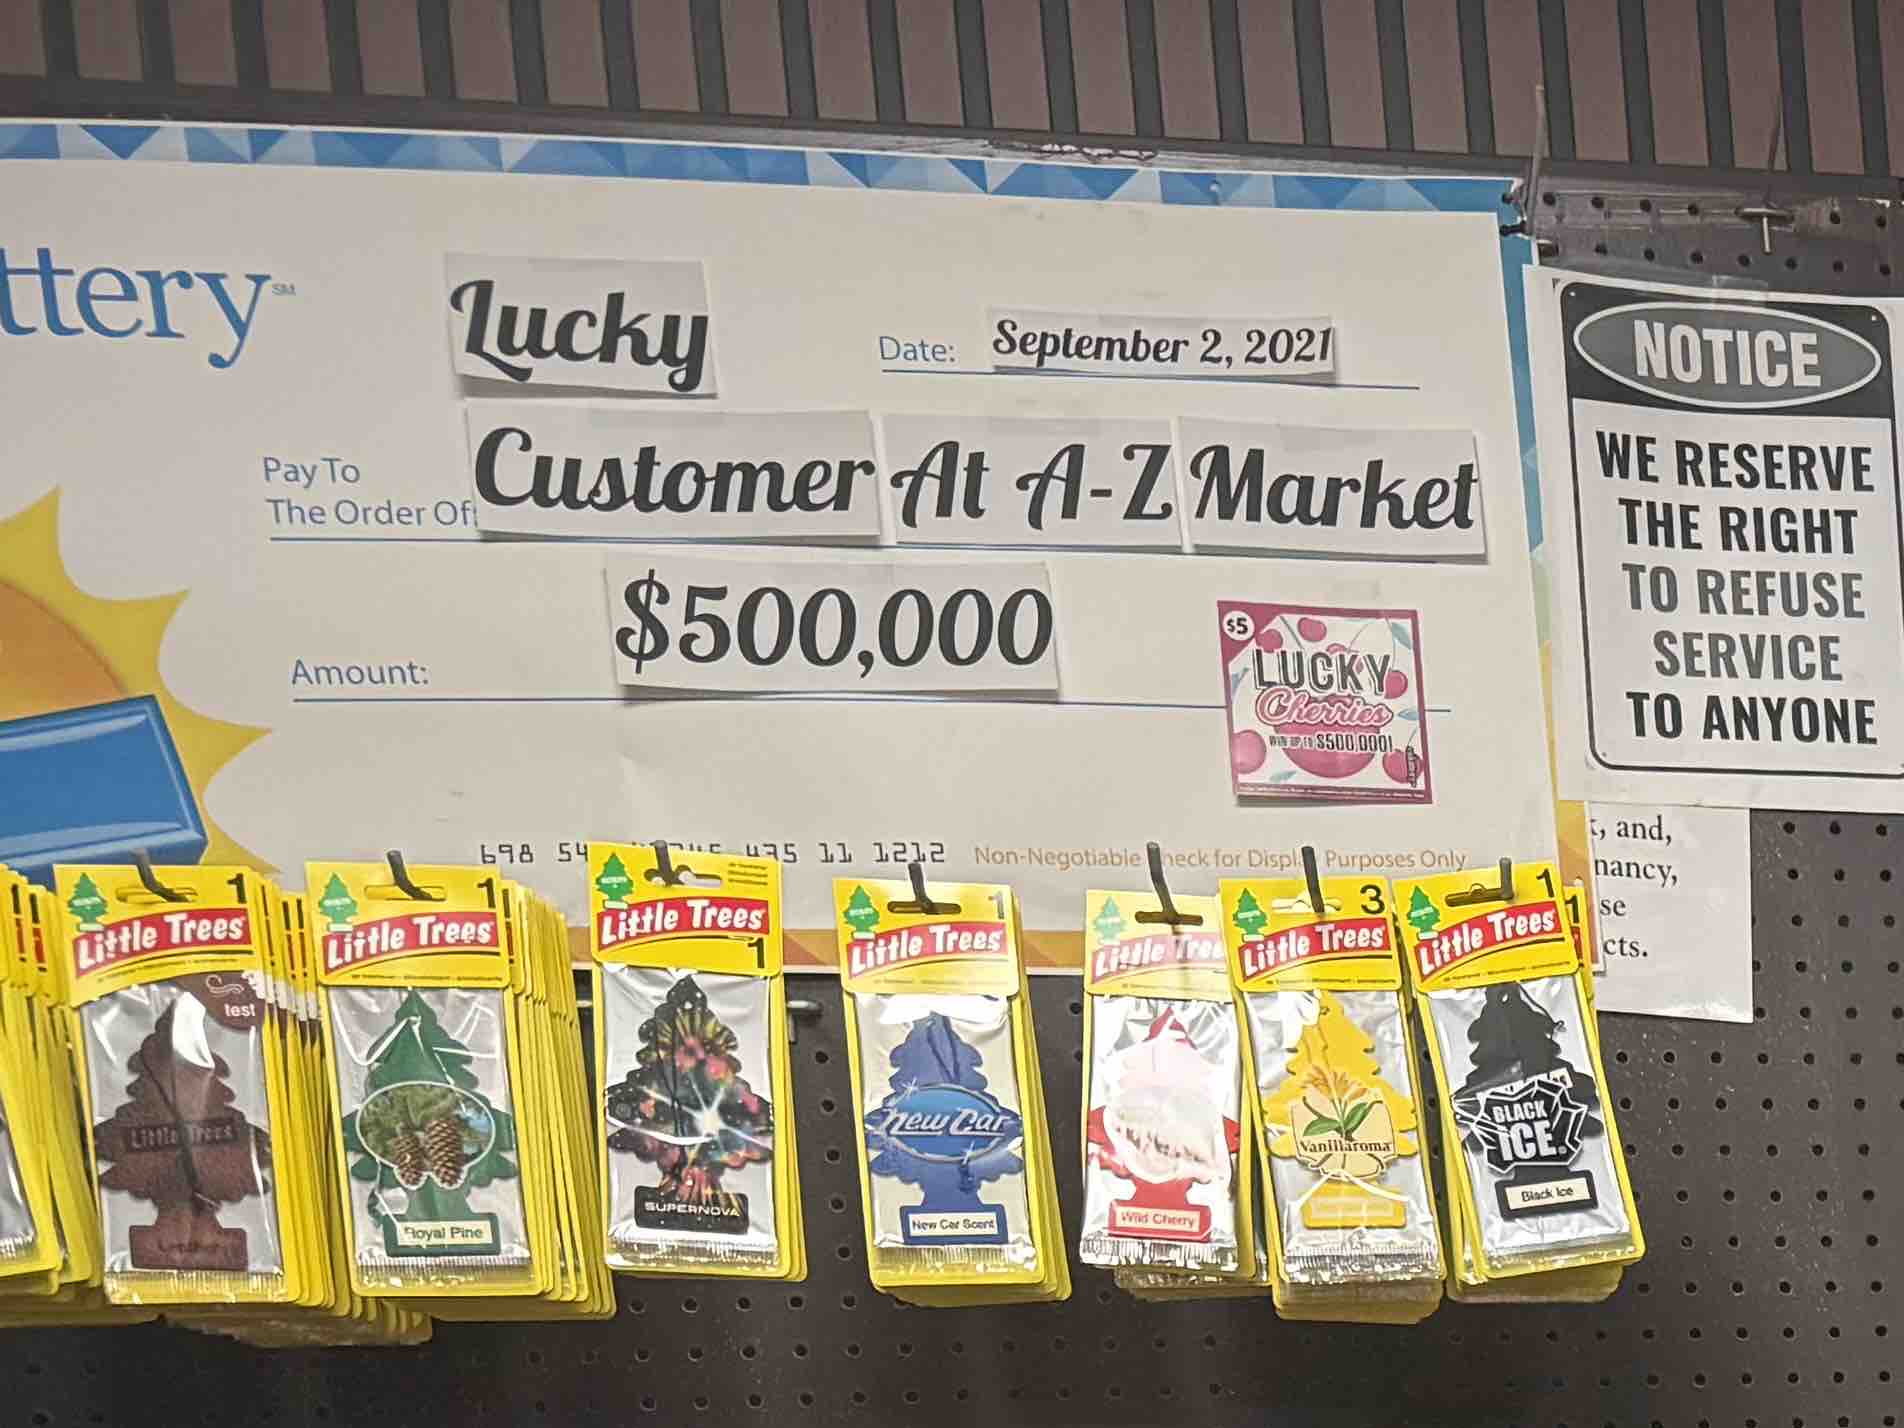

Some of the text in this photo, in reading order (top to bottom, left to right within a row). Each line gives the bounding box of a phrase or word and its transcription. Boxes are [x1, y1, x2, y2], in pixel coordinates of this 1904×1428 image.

[450, 278, 709, 392] Lucky
[878, 319, 1332, 368] Date: September 2, 2021
[1632, 319, 1822, 388] NOTICE
[263, 457, 361, 489] Pay To
[474, 426, 1478, 530] Customer At A-Z Market
[1596, 431, 1875, 494] WE RESERVE
[267, 499, 423, 525] The Order
[1618, 497, 1857, 555] THE RIGHT
[1622, 562, 1864, 621] TO REFUSE
[614, 568, 1055, 678] $500,000
[290, 659, 430, 688] Amount:
[1253, 648, 1390, 696] LUCKY
[1653, 628, 1845, 681] SERVICE
[1256, 687, 1392, 726] Cherries
[1625, 690, 1878, 746] TO ANYONE
[1617, 814, 1672, 846] and,
[974, 845, 1467, 870] Non-Negotiable for Purposes Only
[599, 896, 764, 937] Little Trees
[1360, 885, 1385, 914] 3
[325, 913, 495, 969] Little Trees
[850, 926, 1001, 971] Little Trees
[1418, 910, 1557, 974] Little Trees
[1493, 1100, 1549, 1125] BLACK
[644, 1200, 740, 1218] SUPERNOVA
